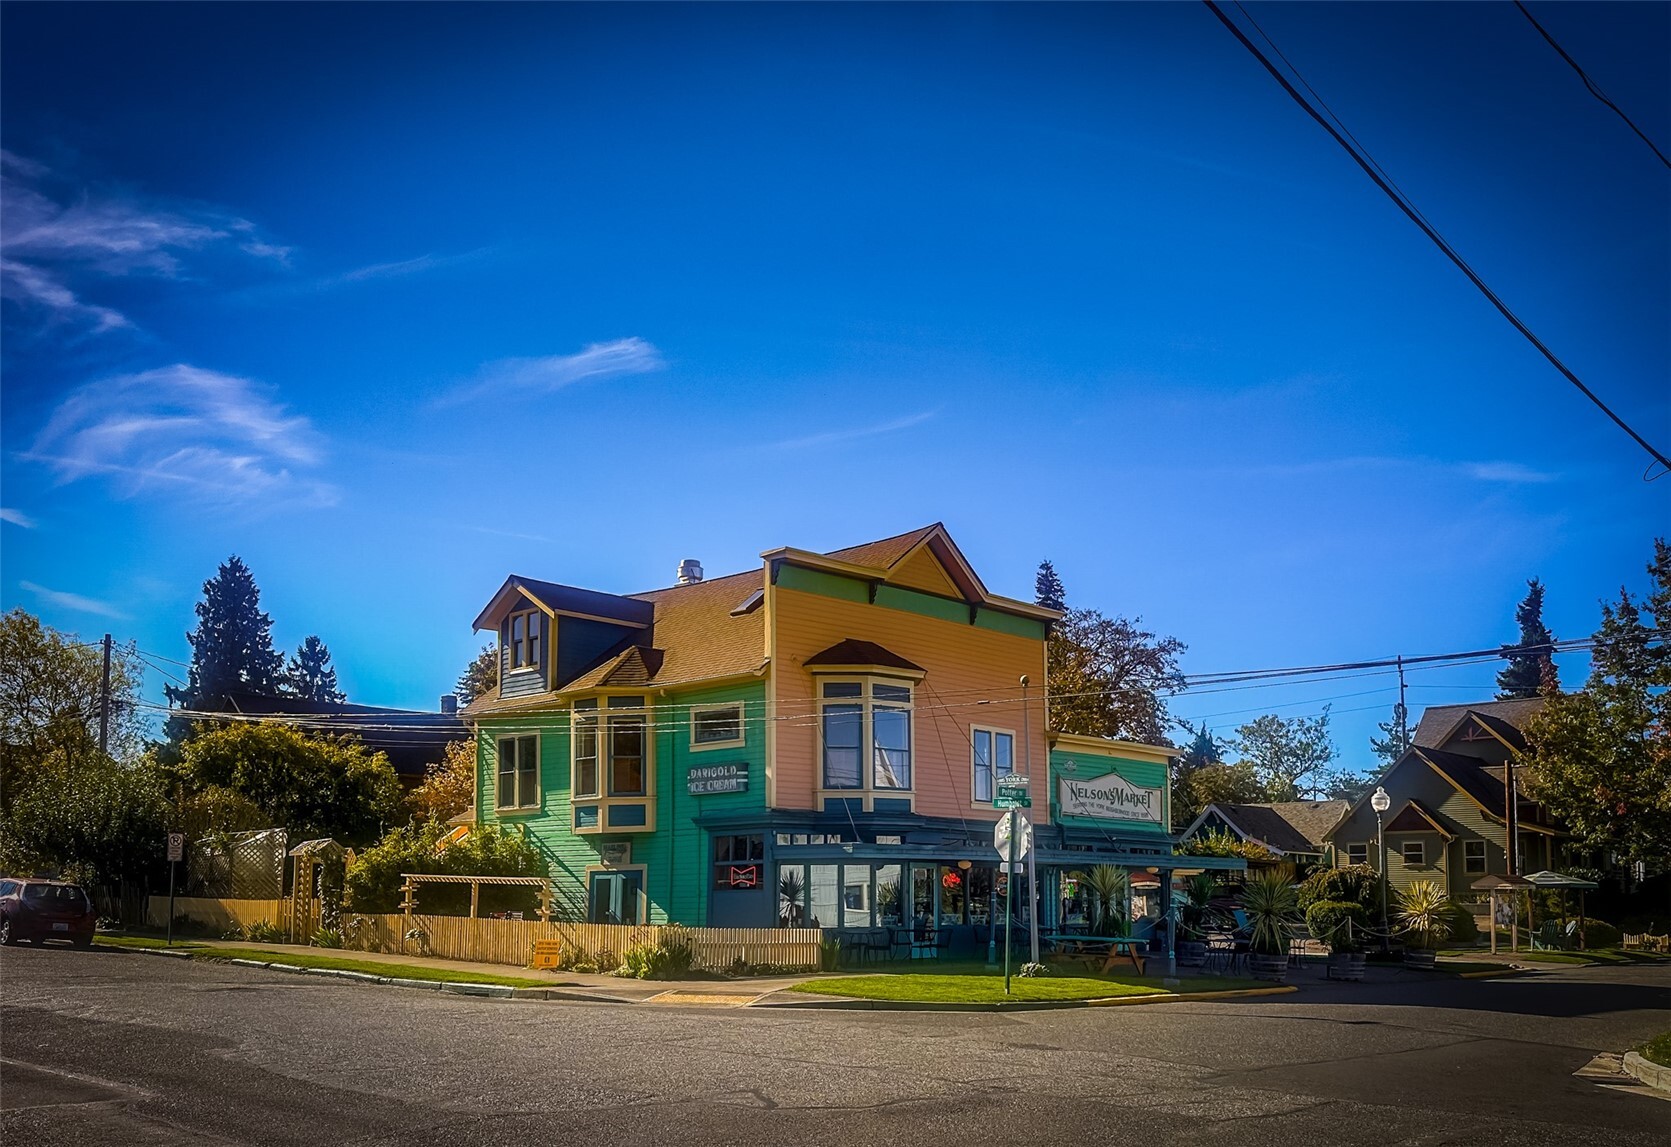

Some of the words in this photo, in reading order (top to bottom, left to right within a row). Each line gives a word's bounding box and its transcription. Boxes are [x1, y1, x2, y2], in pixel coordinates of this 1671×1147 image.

[690, 765, 737, 779] DARIGOLD
[691, 781, 706, 793] ICE
[1113, 787, 1153, 808] MARKET
